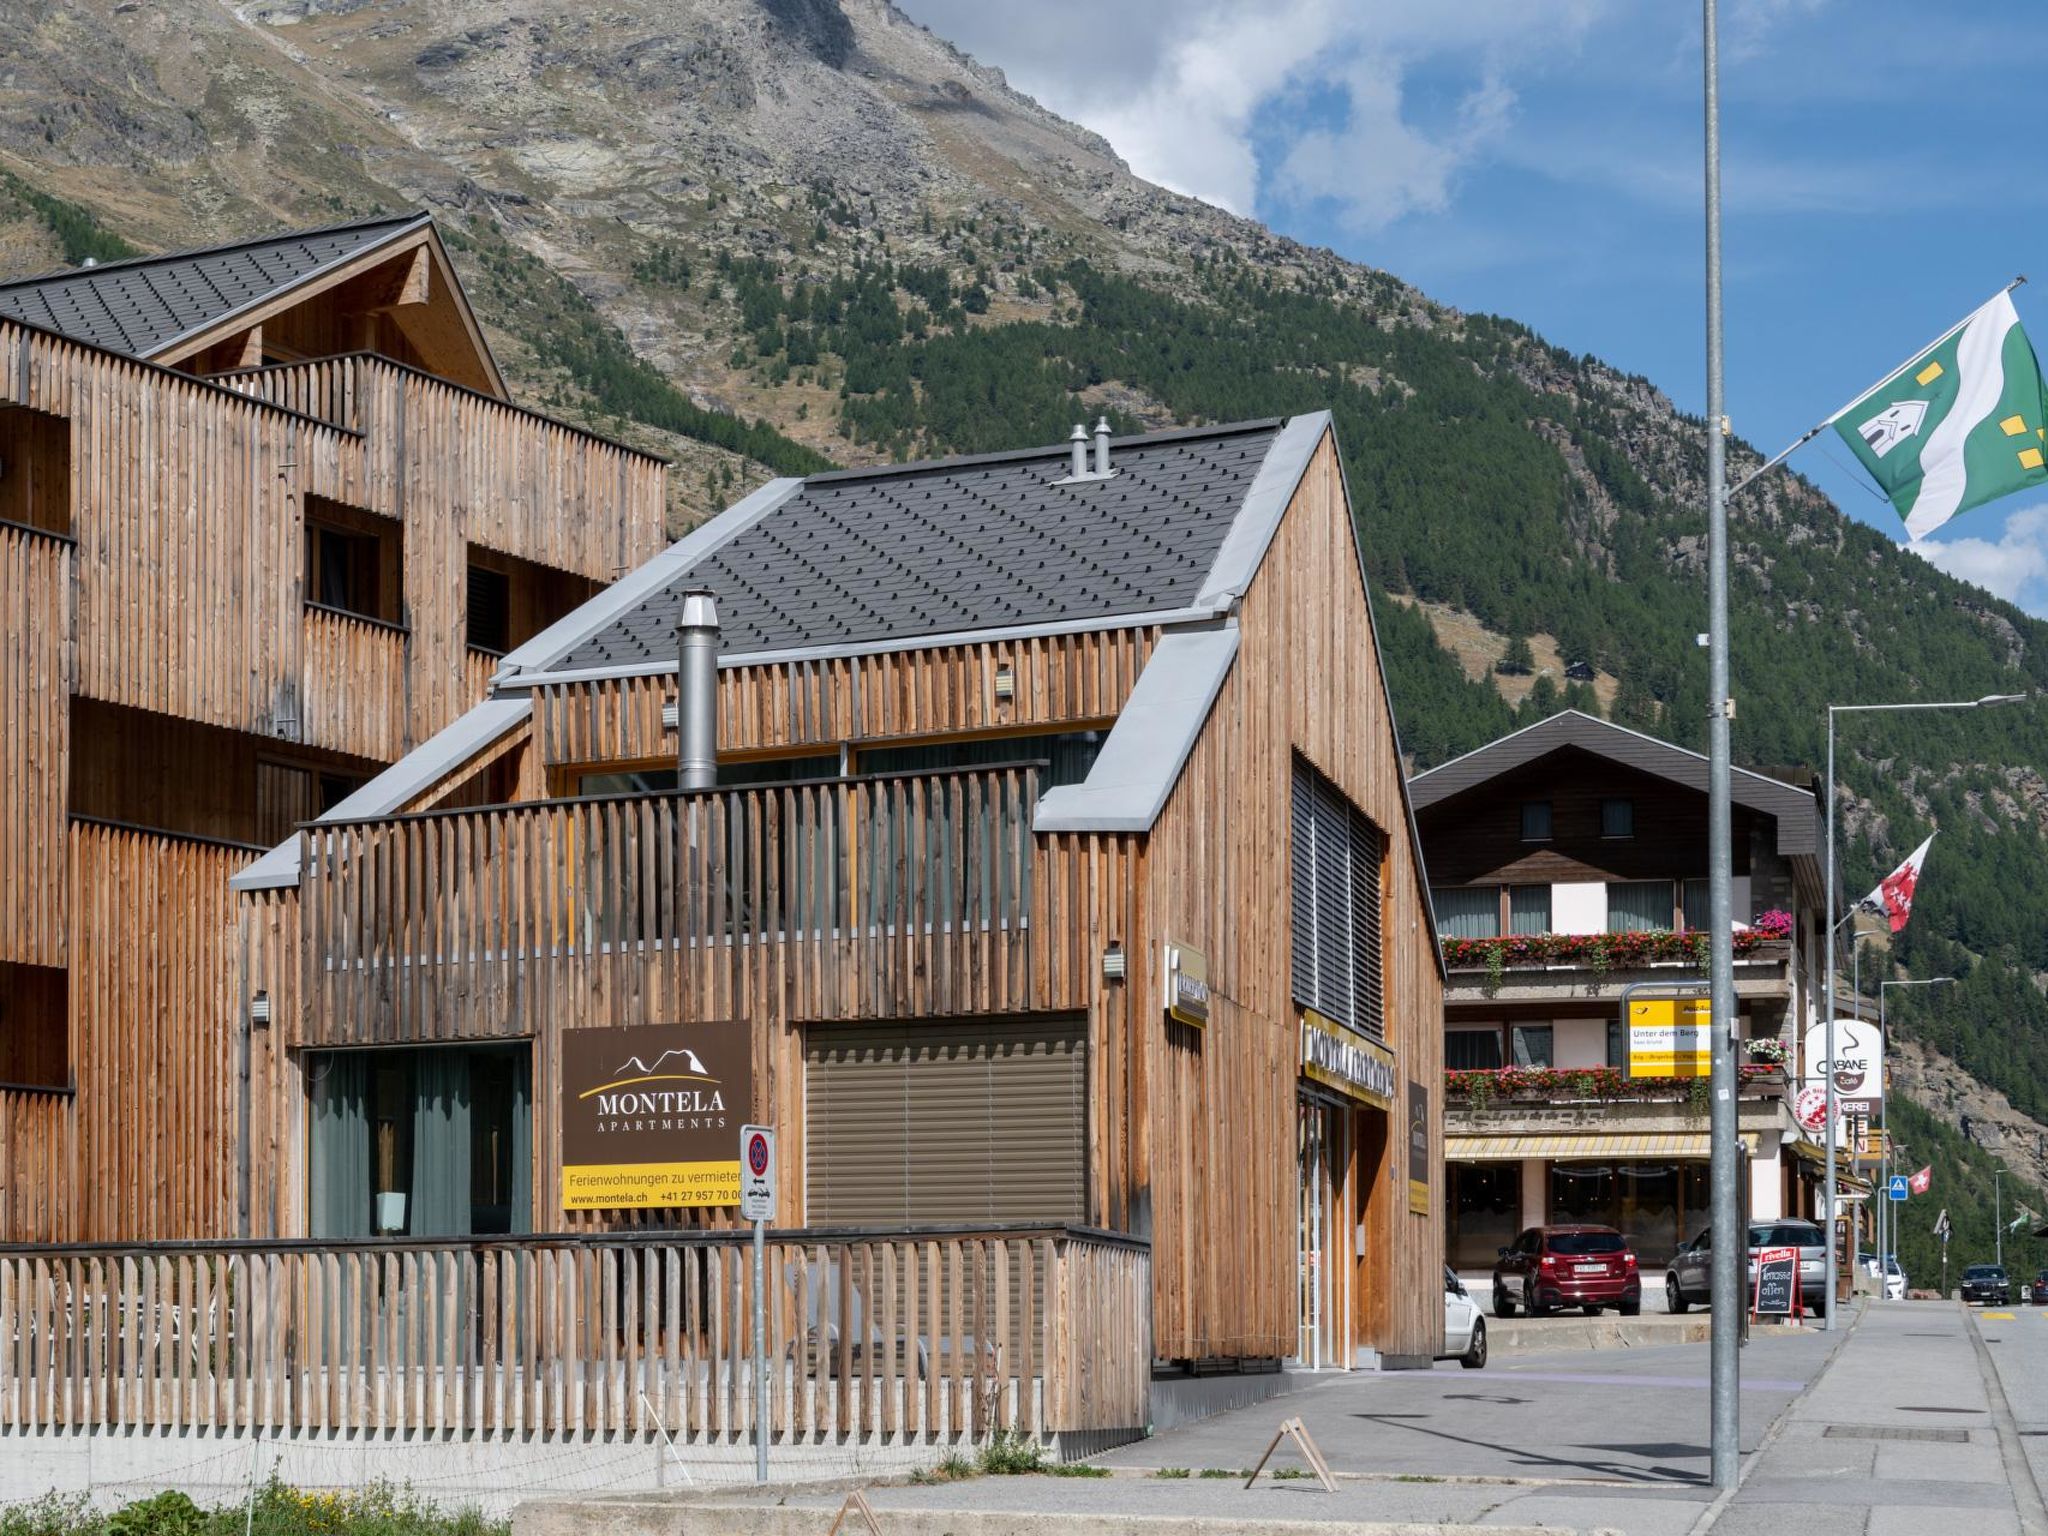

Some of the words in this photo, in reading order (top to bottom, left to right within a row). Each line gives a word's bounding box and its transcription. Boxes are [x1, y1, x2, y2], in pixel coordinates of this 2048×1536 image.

[1633, 1029, 1657, 1038] Unter
[1659, 1029, 1678, 1037] dem
[1680, 1028, 1699, 1039] Berg
[597, 1090, 726, 1116] MONTELA
[597, 1117, 726, 1132] APARTMENTS
[569, 1173, 669, 1188] Ferienwohnungen
[671, 1173, 685, 1184] zu
[570, 1193, 648, 1204] www.montela.ch
[660, 1191, 678, 1201] +41
[681, 1190, 694, 1200] 27
[695, 1190, 714, 1200] 957
[716, 1189, 729, 1200] 70
[1765, 1249, 1792, 1260] rivella
[1761, 1282, 1785, 1296] offen
